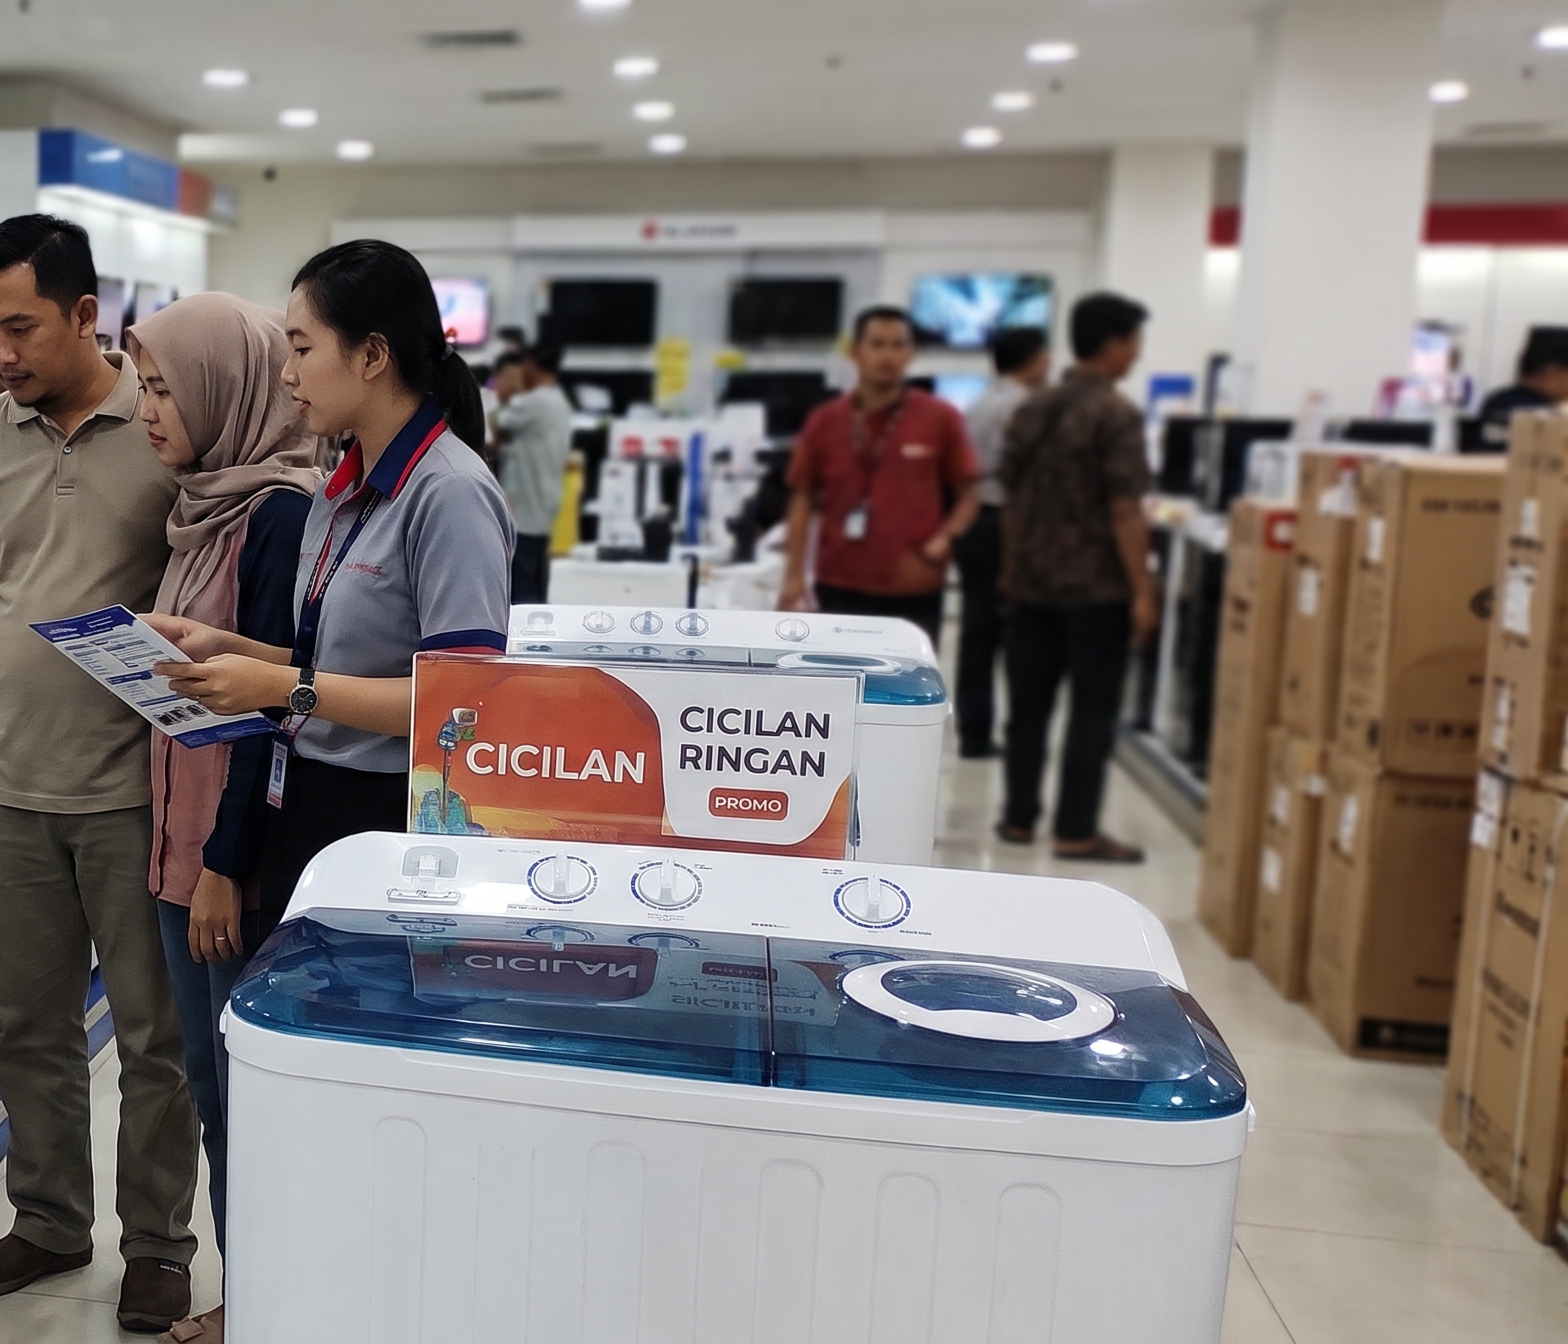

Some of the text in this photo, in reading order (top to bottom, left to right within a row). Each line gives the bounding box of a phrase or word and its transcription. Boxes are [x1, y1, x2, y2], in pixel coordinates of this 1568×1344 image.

[680, 705, 831, 740] CICILAN
[466, 742, 645, 784] CICILAN
[679, 743, 826, 778] RINGAN
[714, 796, 783, 813] PROMO
